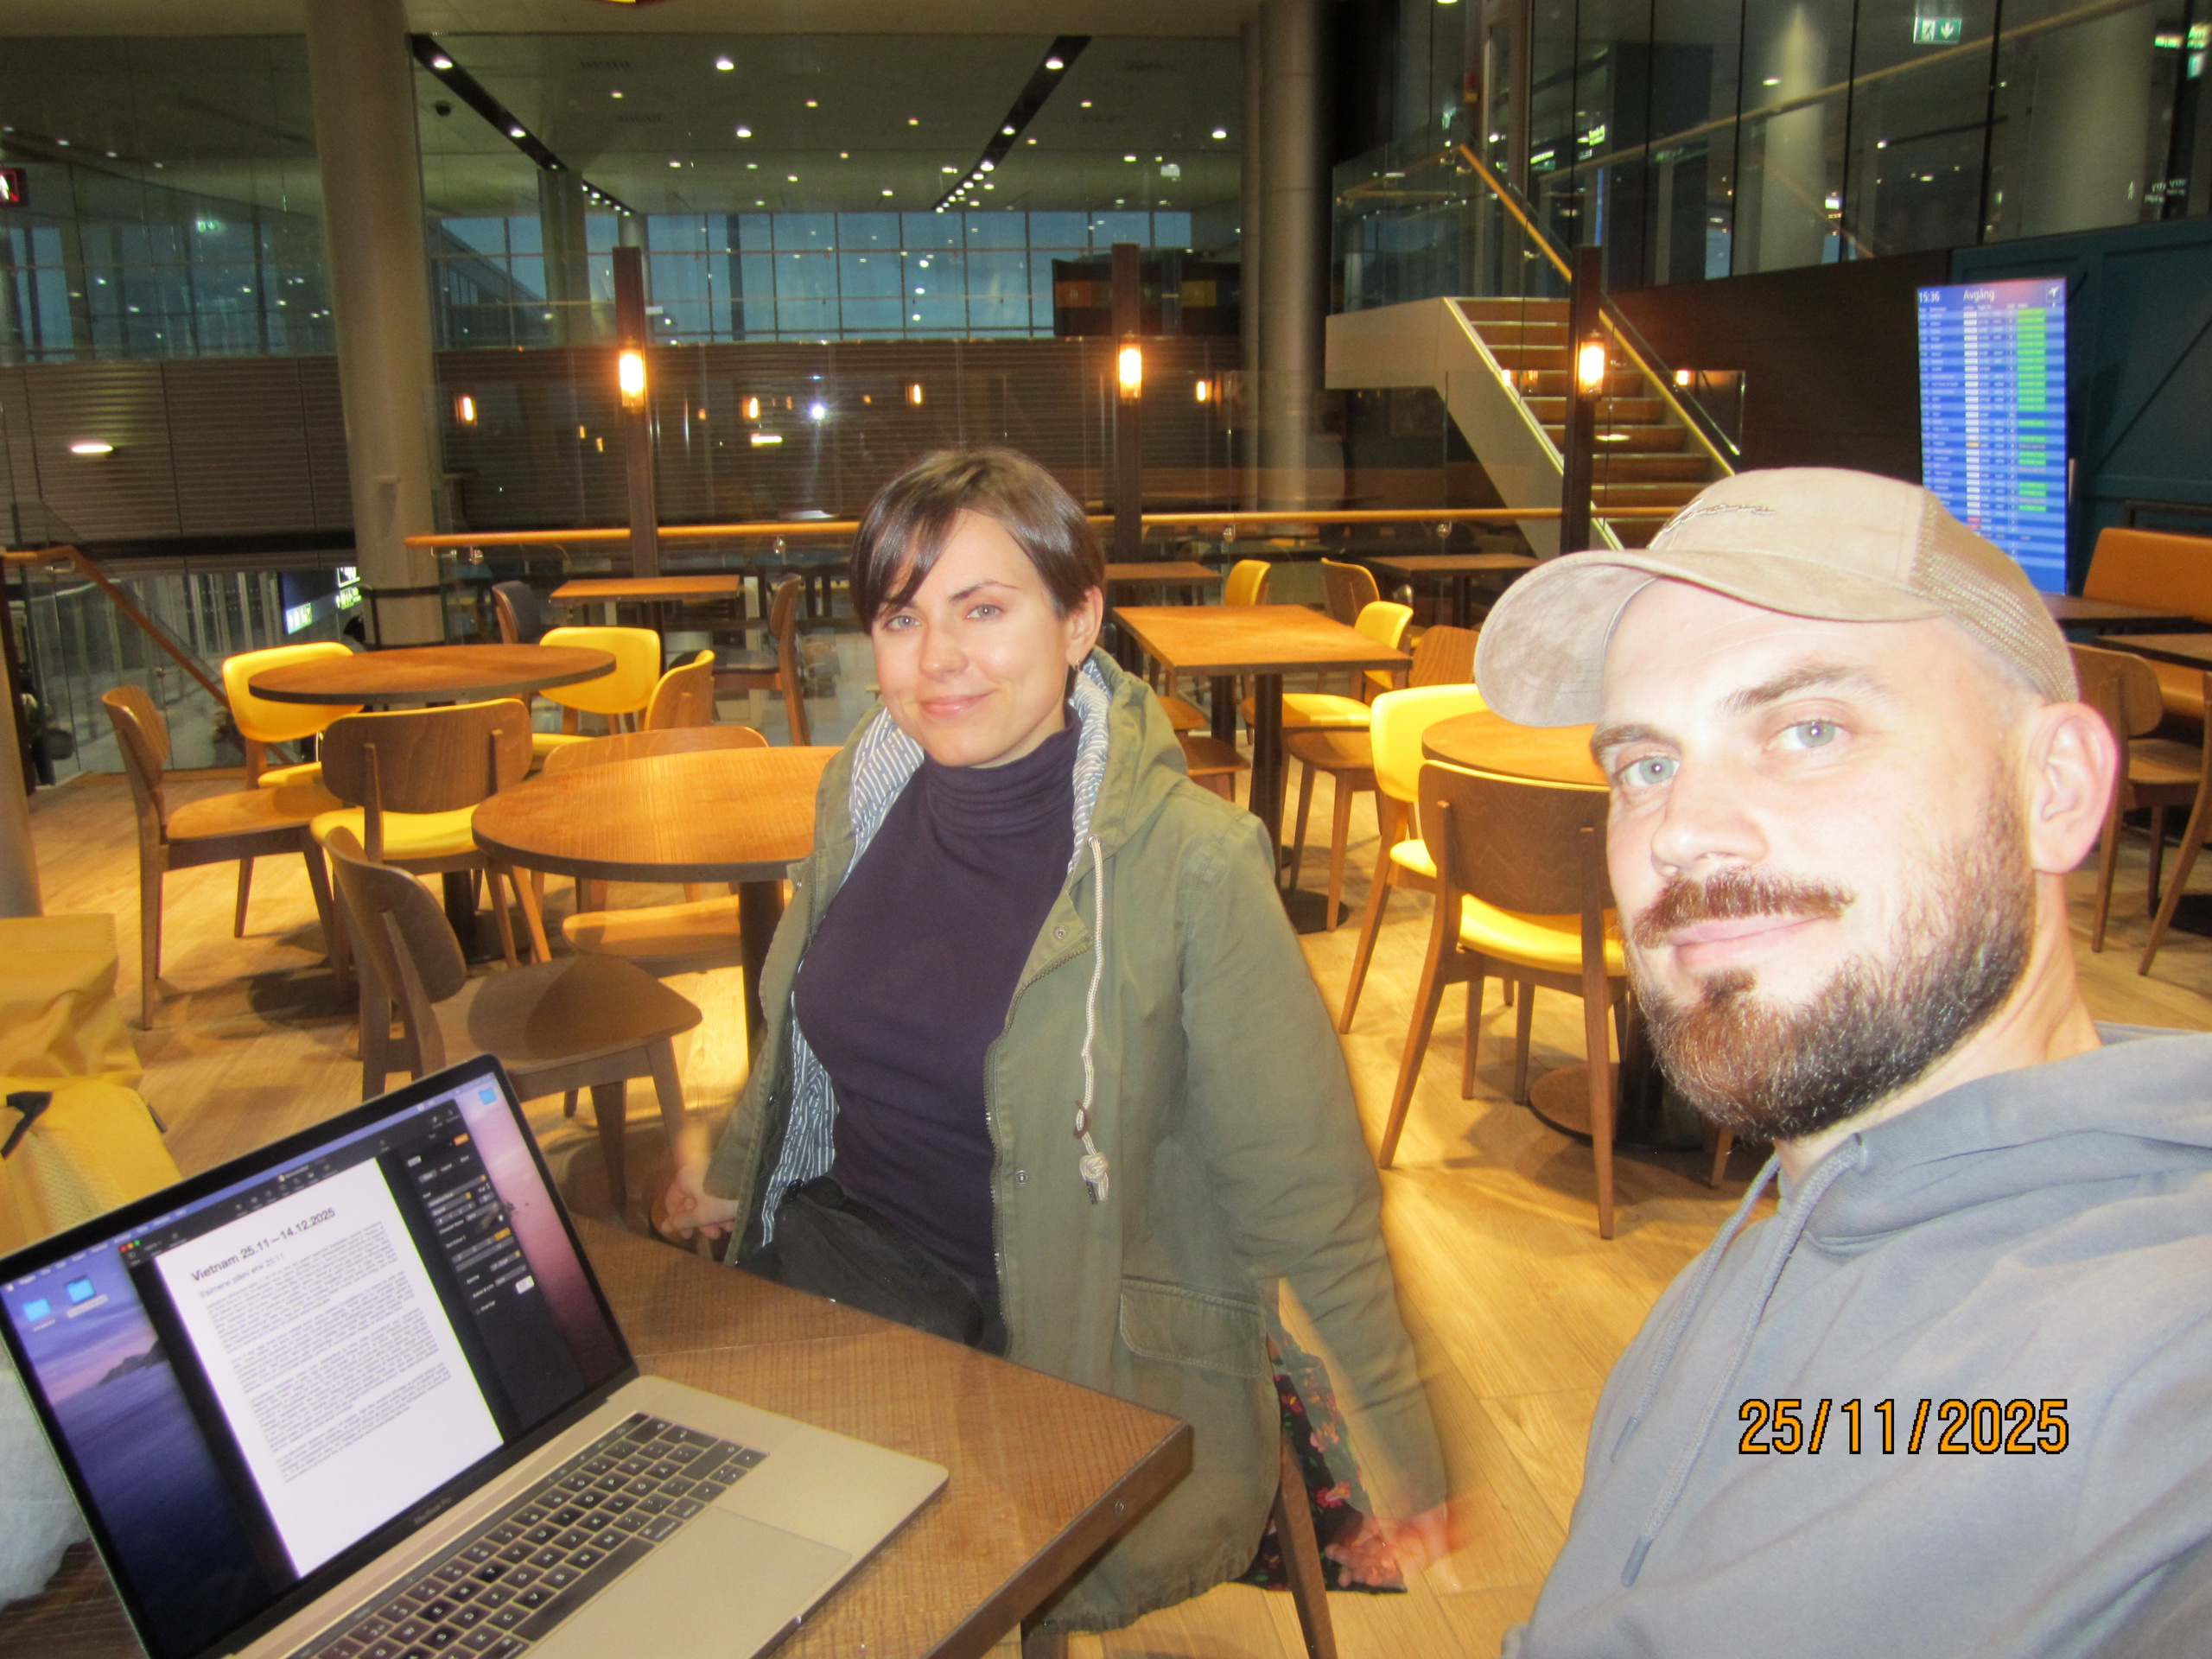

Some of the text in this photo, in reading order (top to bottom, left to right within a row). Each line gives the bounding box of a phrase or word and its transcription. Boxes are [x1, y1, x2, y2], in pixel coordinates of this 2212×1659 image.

[1919, 290, 1940, 303] 15:36
[1962, 288, 1995, 303] Avgång
[191, 1255, 239, 1281] Vietnam
